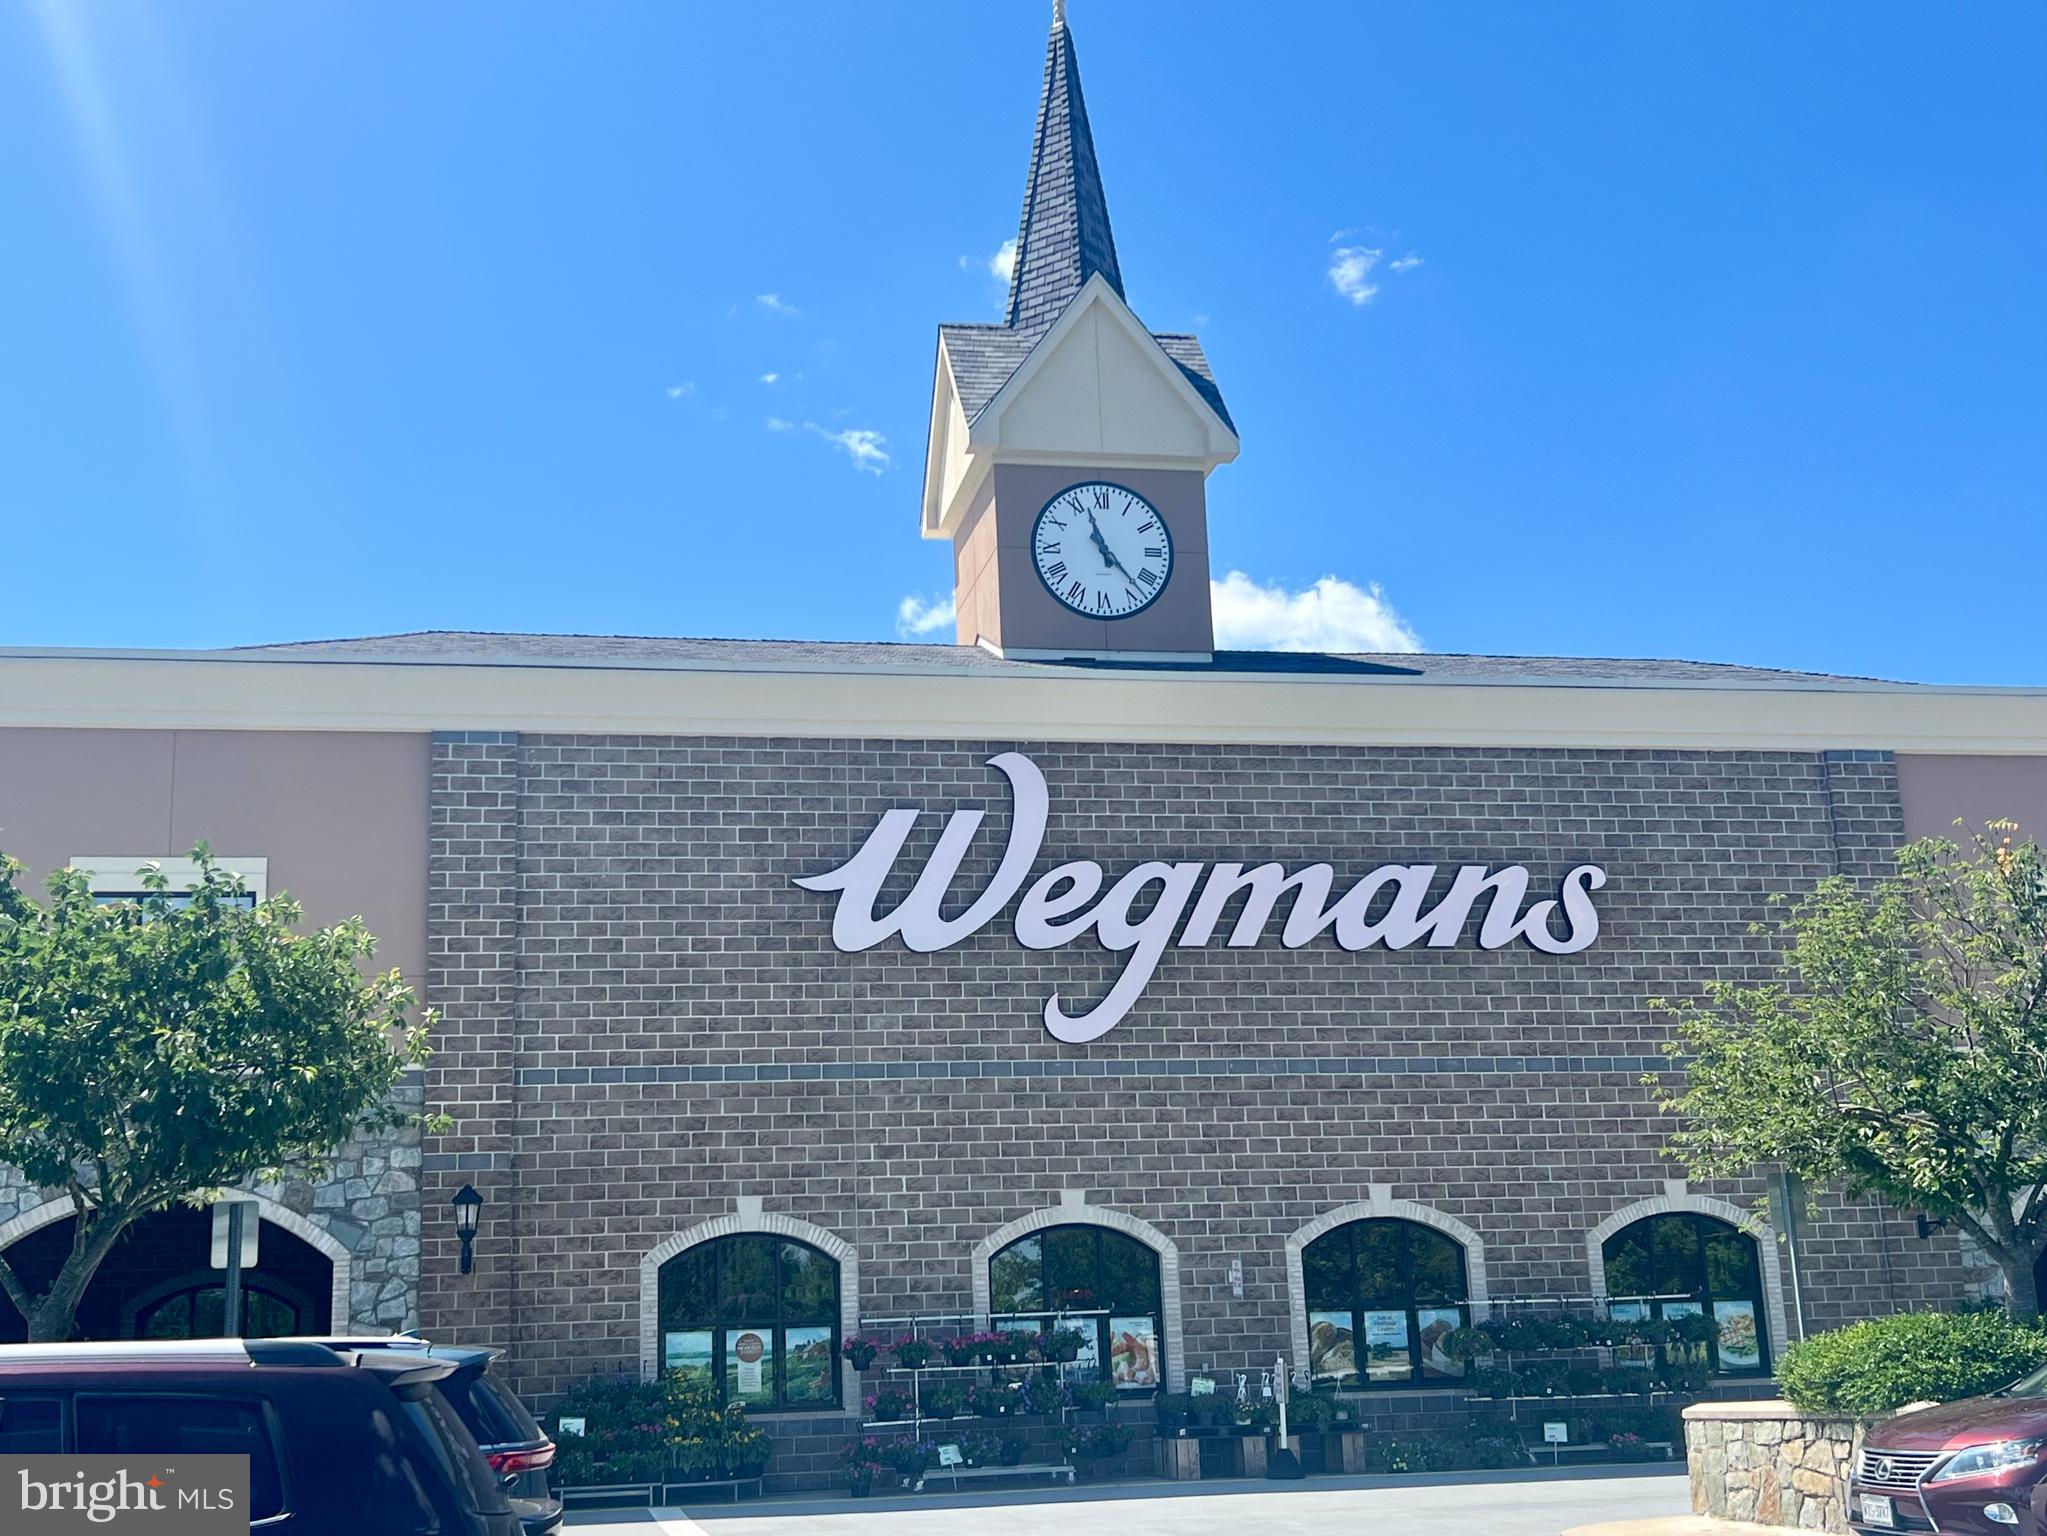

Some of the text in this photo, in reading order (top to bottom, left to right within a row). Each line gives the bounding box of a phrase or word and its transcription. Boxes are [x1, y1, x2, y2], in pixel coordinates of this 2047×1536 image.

[1067, 496, 1085, 516] XI
[1094, 492, 1109, 510] XII
[1049, 515, 1068, 532] X
[1137, 521, 1154, 534] II
[1043, 542, 1061, 554] IX
[1144, 547, 1162, 558] III
[1048, 561, 1068, 585] VIII
[1068, 581, 1087, 604] VII
[792, 752, 1606, 1043] Wegmans
